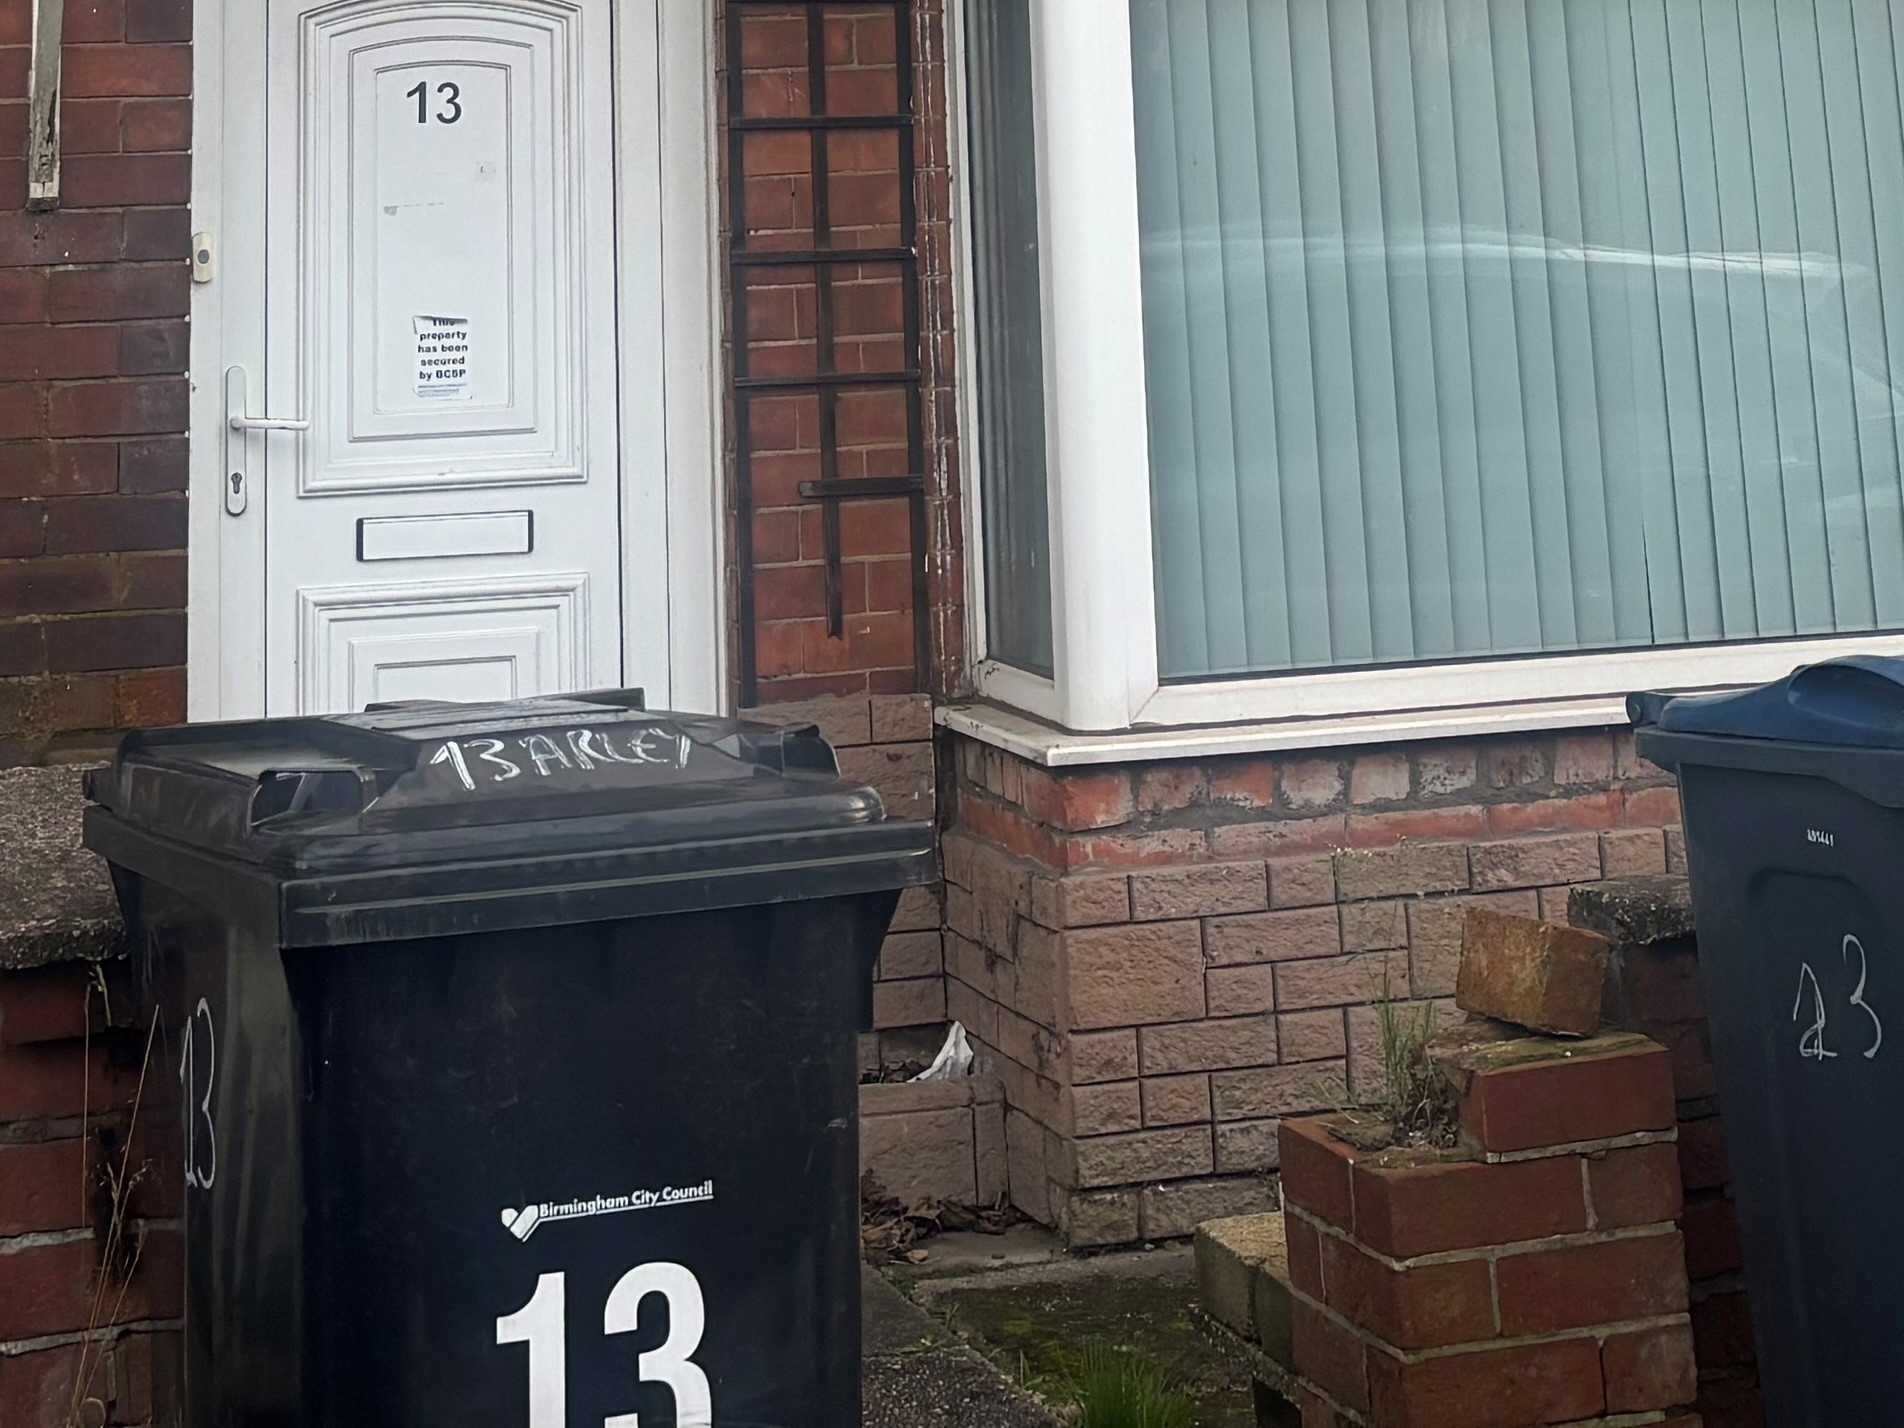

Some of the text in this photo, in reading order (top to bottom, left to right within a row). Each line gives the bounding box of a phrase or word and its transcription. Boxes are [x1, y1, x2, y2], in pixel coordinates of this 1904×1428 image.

[406, 81, 462, 125] 13
[417, 343, 468, 353] has been
[419, 330, 467, 342] property
[420, 355, 465, 366] secured
[419, 370, 432, 381] by
[430, 739, 520, 790] 13
[539, 1180, 713, 1218] Birmingham City Council
[496, 1262, 712, 1428] 13
